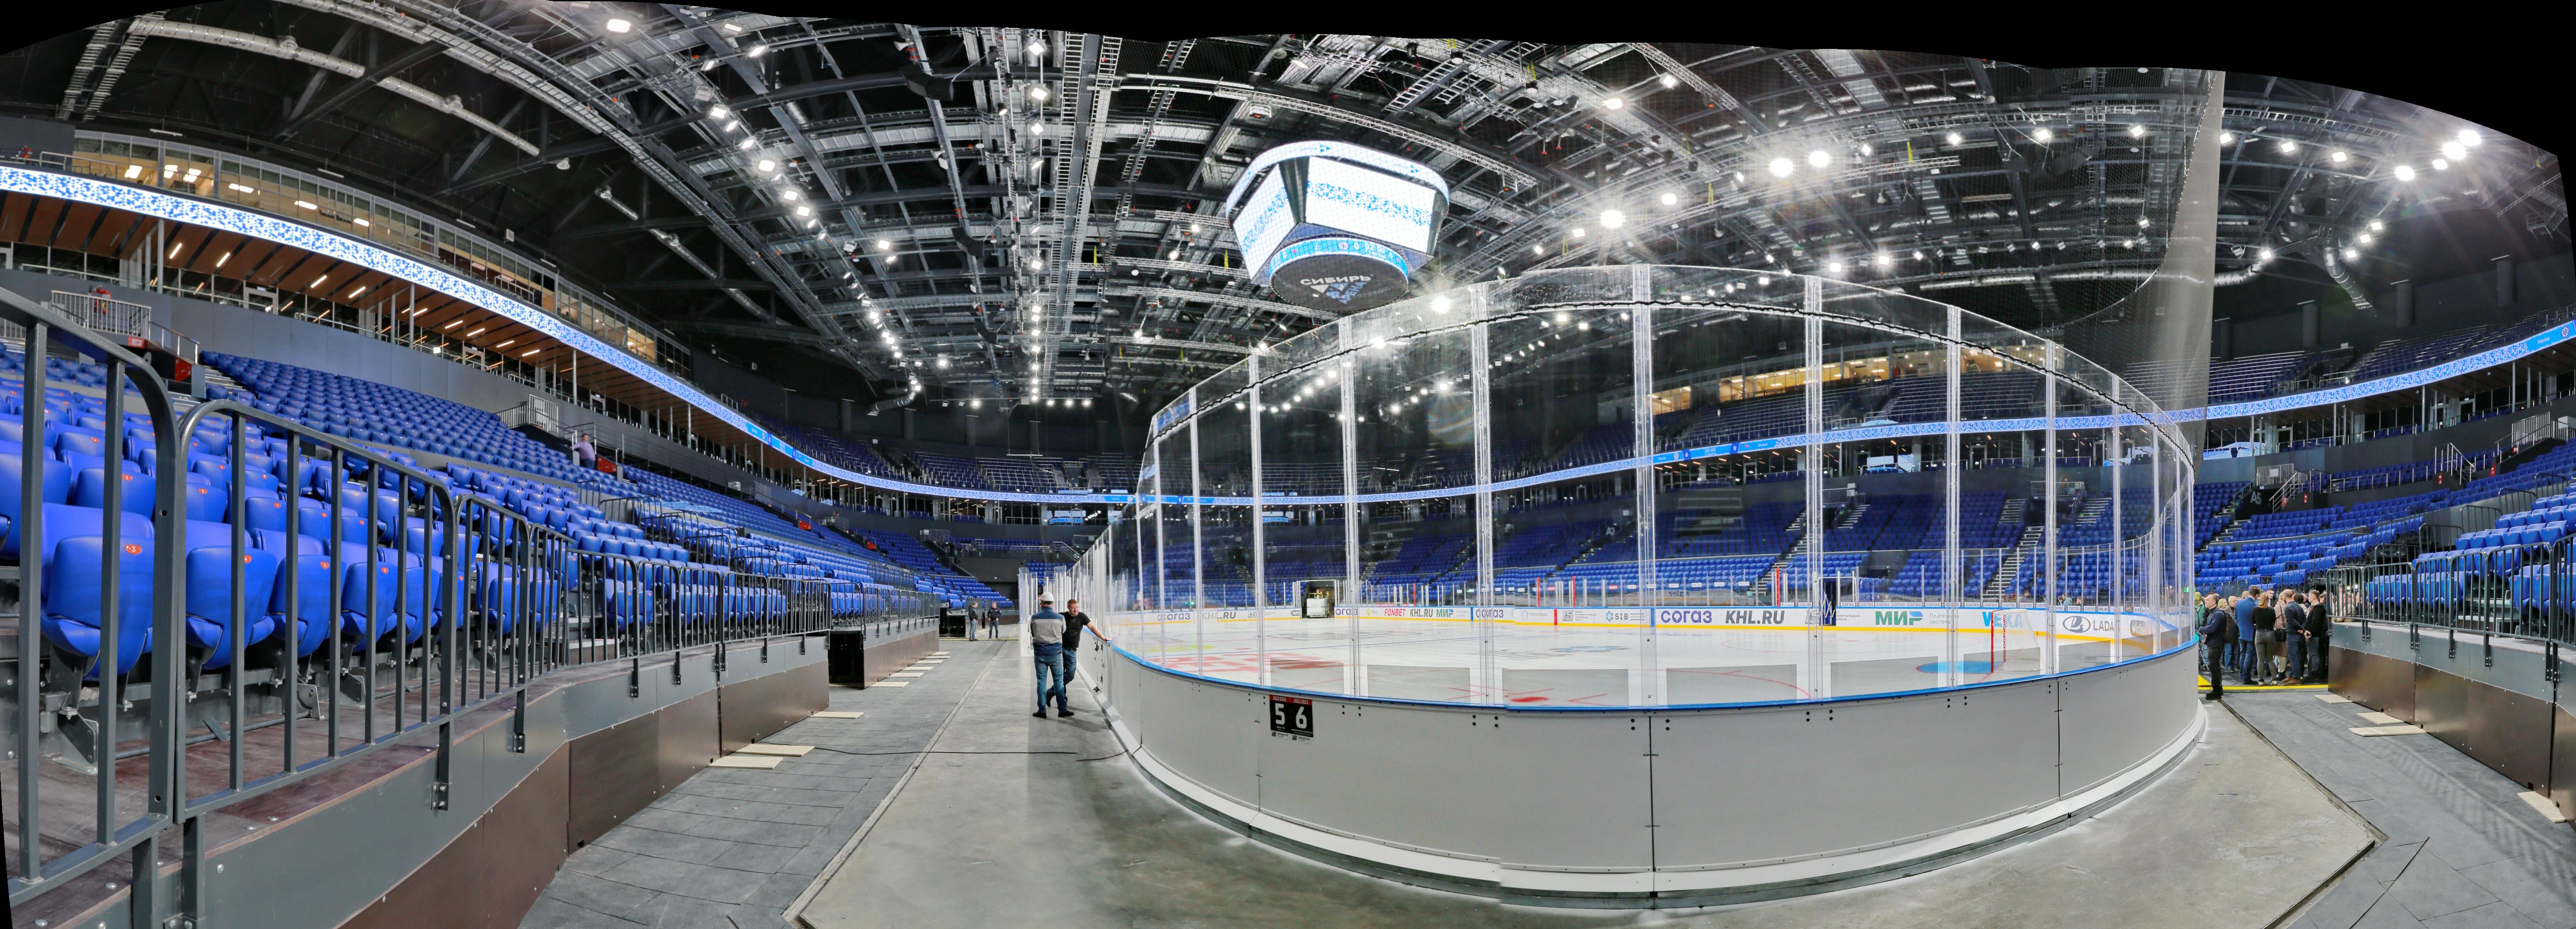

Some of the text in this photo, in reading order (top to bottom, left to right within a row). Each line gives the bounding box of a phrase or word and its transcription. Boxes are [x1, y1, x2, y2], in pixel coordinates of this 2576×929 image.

[1389, 252, 1393, 260] 0
[1300, 275, 1371, 285] СИБИРЬ
[1339, 282, 1367, 304] АРЕНА
[2250, 491, 2262, 505] A5
[1384, 609, 1406, 617] FONBET
[1410, 609, 1433, 618] KHL.RU
[1436, 609, 1454, 618] МИР
[1661, 610, 1712, 623] согаз
[1725, 610, 1785, 624] KHL.RU
[1875, 611, 1923, 625] МИР
[1982, 611, 2024, 628] VEKA
[2093, 620, 2115, 632] LADA
[1275, 703, 1285, 725] 5
[1296, 706, 1307, 729] 6
